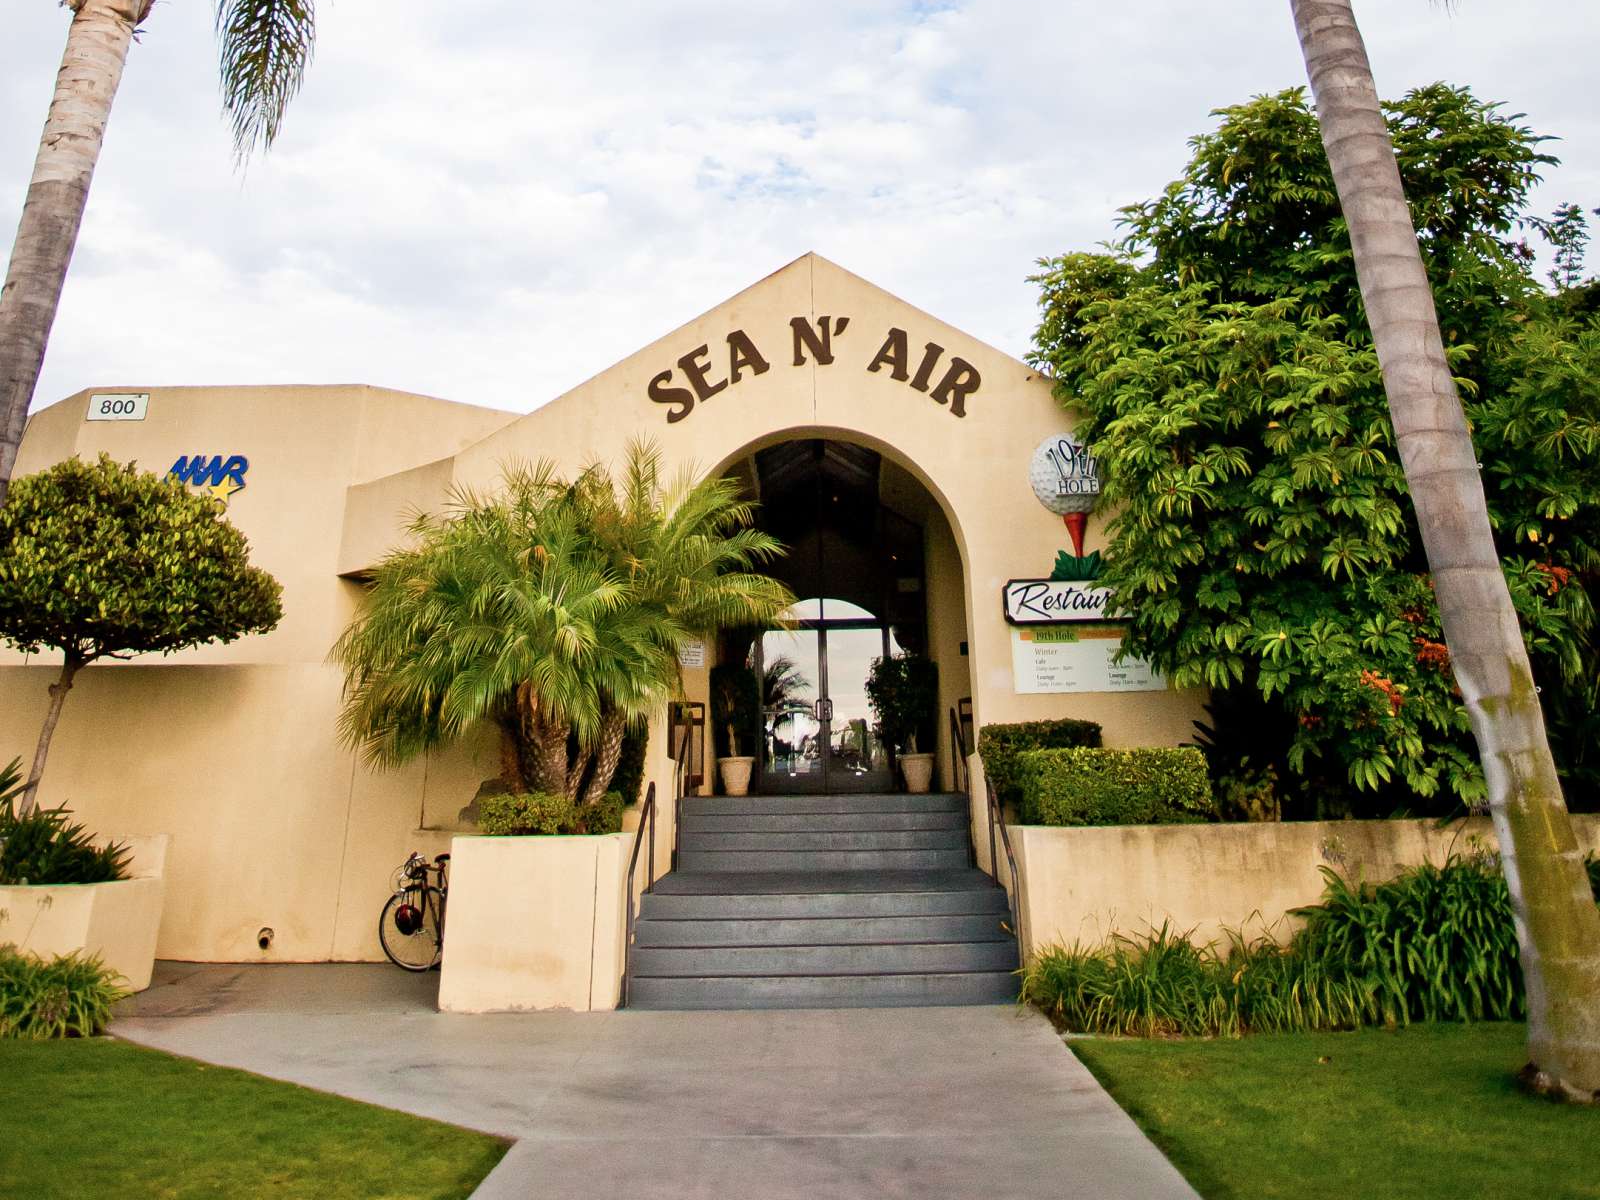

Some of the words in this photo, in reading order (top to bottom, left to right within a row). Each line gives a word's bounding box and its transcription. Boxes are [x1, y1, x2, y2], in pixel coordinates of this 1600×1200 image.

[648, 329, 770, 423] SEA
[789, 315, 850, 366] N'
[866, 327, 982, 418] AIR
[100, 400, 135, 414] 800
[163, 455, 249, 487] MWR
[1047, 439, 1098, 479] 19th
[1058, 480, 1098, 494] HOLE
[1011, 583, 1111, 618] Restaur
[1055, 631, 1074, 641] Hole
